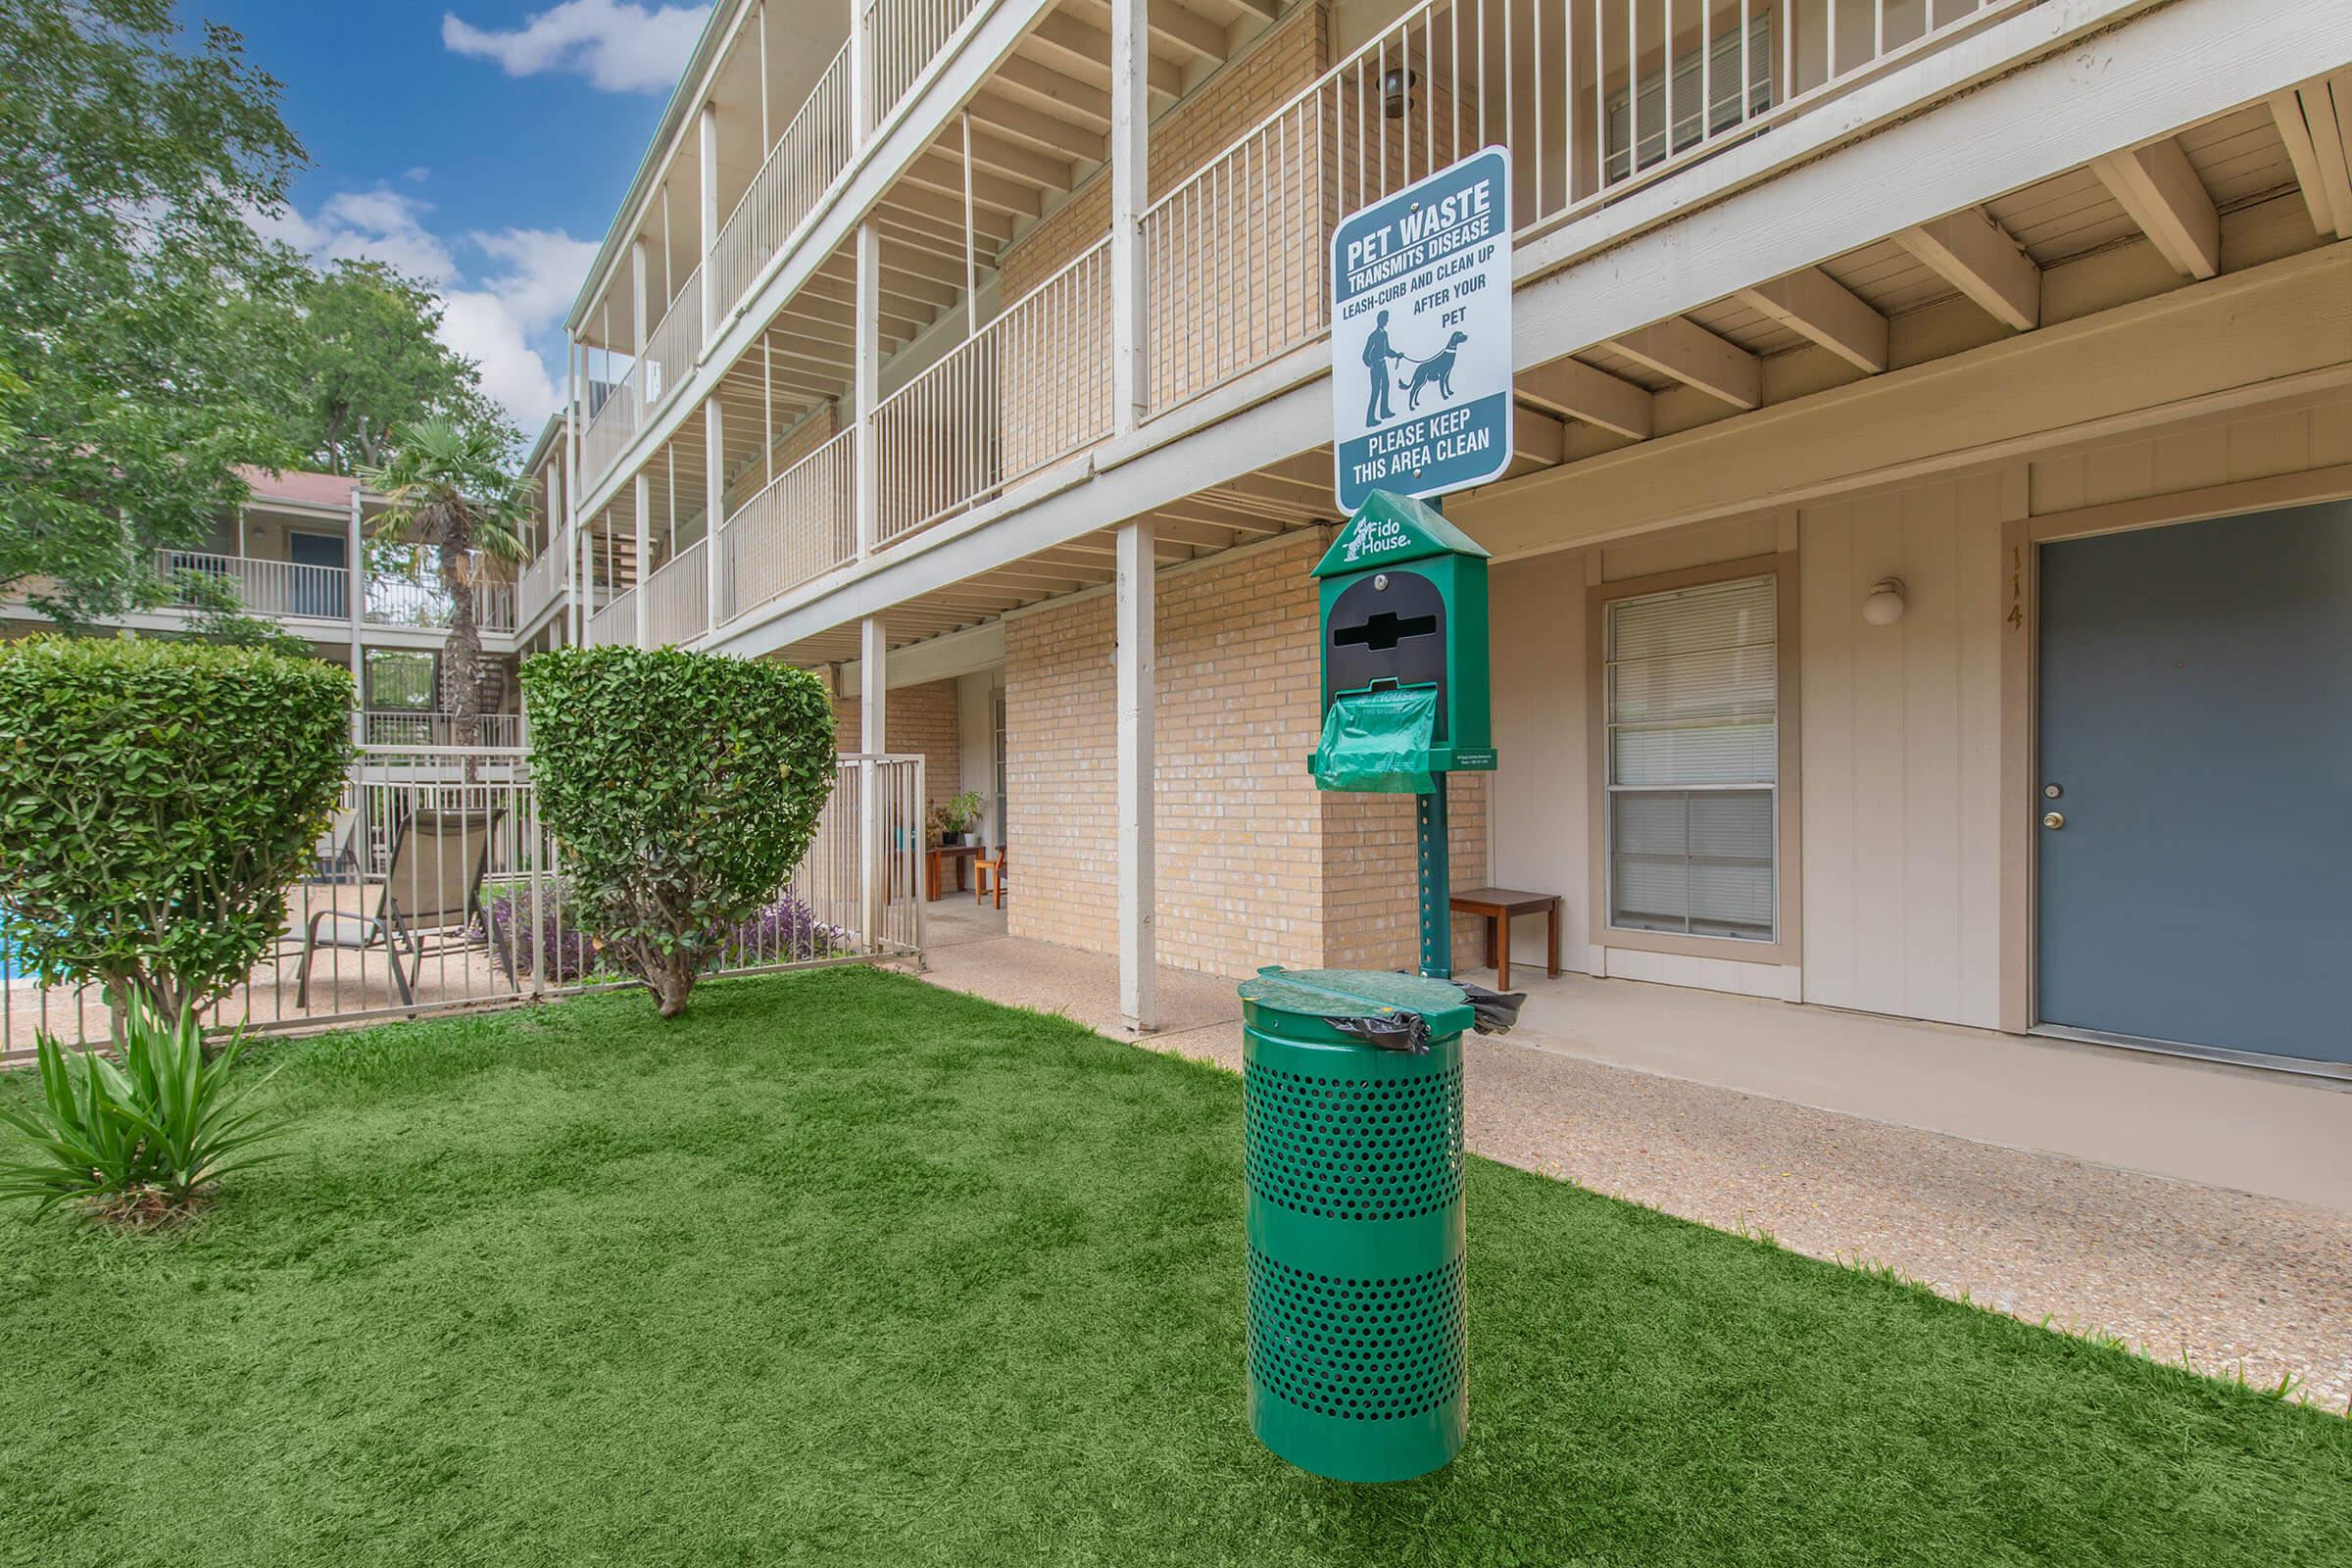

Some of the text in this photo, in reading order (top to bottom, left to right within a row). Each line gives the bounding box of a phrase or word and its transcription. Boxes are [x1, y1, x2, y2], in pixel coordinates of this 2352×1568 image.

[1348, 179, 1491, 271] PET WASTE
[1343, 245, 1494, 320] LEASH-CURB AND CLEAN UP
[1348, 216, 1490, 293] TRANSMITS DISEASE
[1413, 273, 1486, 316] AFTER YOUR
[1442, 306, 1467, 328] PET
[1353, 427, 1490, 485] THIS AREA CLEAN
[1368, 408, 1470, 458] PLEASE KEEP
[1366, 517, 1400, 540] Fido
[2006, 545, 2023, 630] 114
